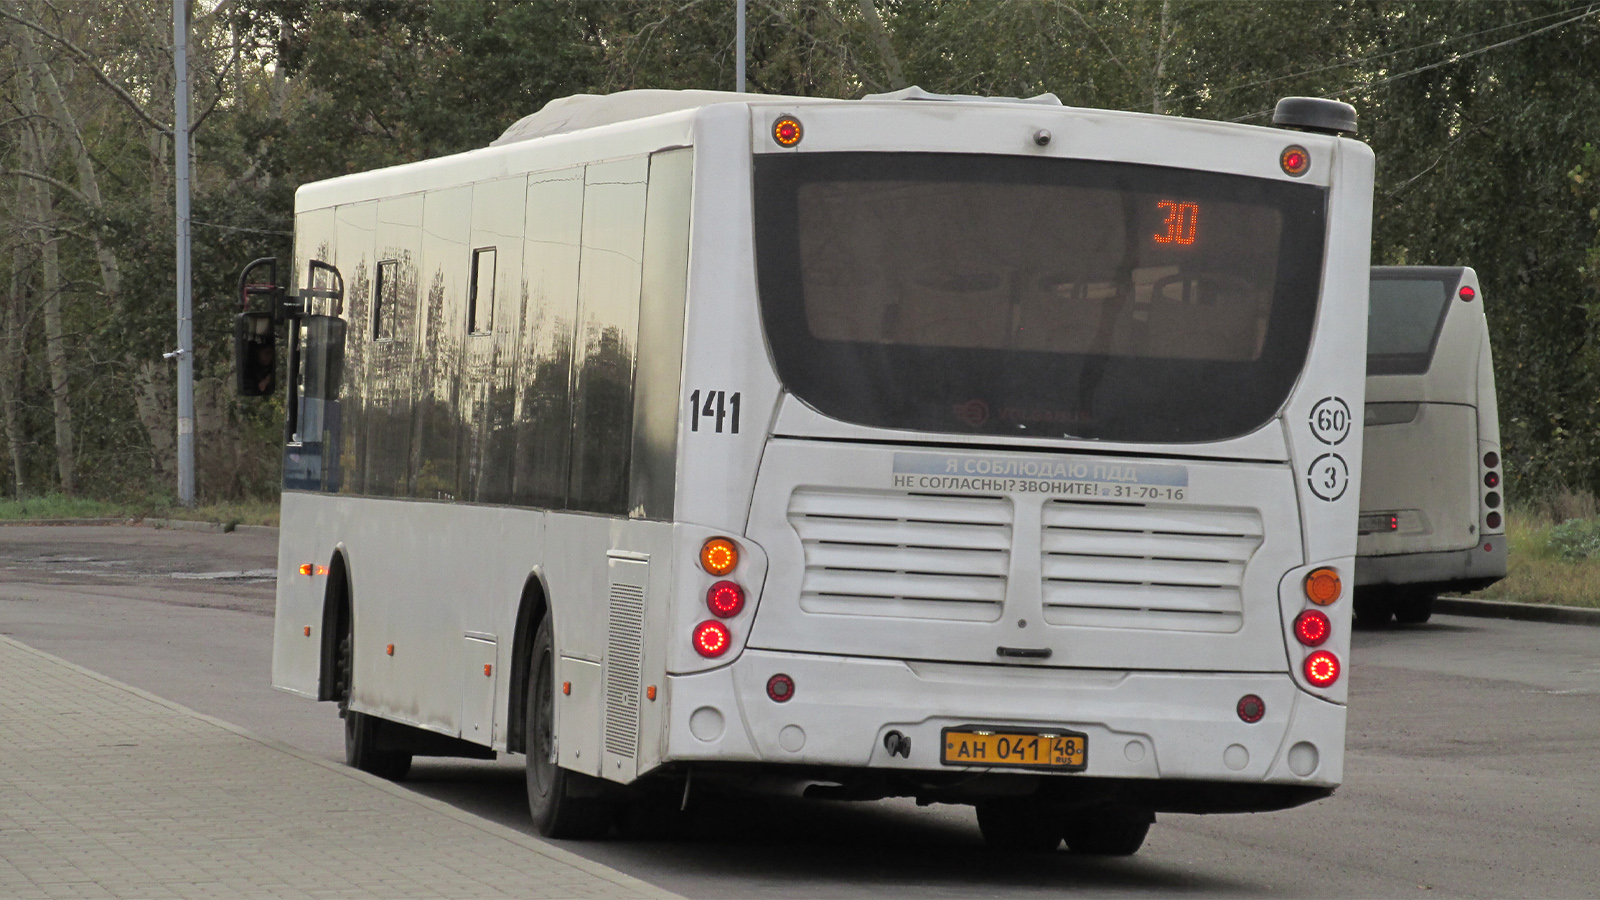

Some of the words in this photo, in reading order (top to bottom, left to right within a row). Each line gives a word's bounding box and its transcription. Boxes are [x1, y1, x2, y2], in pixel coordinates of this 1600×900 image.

[1154, 200, 1199, 245] 30
[690, 389, 741, 434] 141
[1318, 409, 1345, 431] 60
[945, 459, 958, 473] Я
[964, 459, 1088, 479] СОБЛЮДАЮ
[1094, 465, 1137, 482] ПДД
[1324, 466, 1336, 489] 3
[894, 475, 915, 488] НЕ
[919, 476, 1016, 491] СОГЛАСНЫ?
[1019, 480, 1098, 496] ЗВОНИТЕ!
[1114, 485, 1184, 501] 31-70-16
[957, 740, 986, 759] АН
[997, 737, 1039, 761] 041
[1053, 739, 1076, 756] 48
[1056, 756, 1072, 764] RUS
